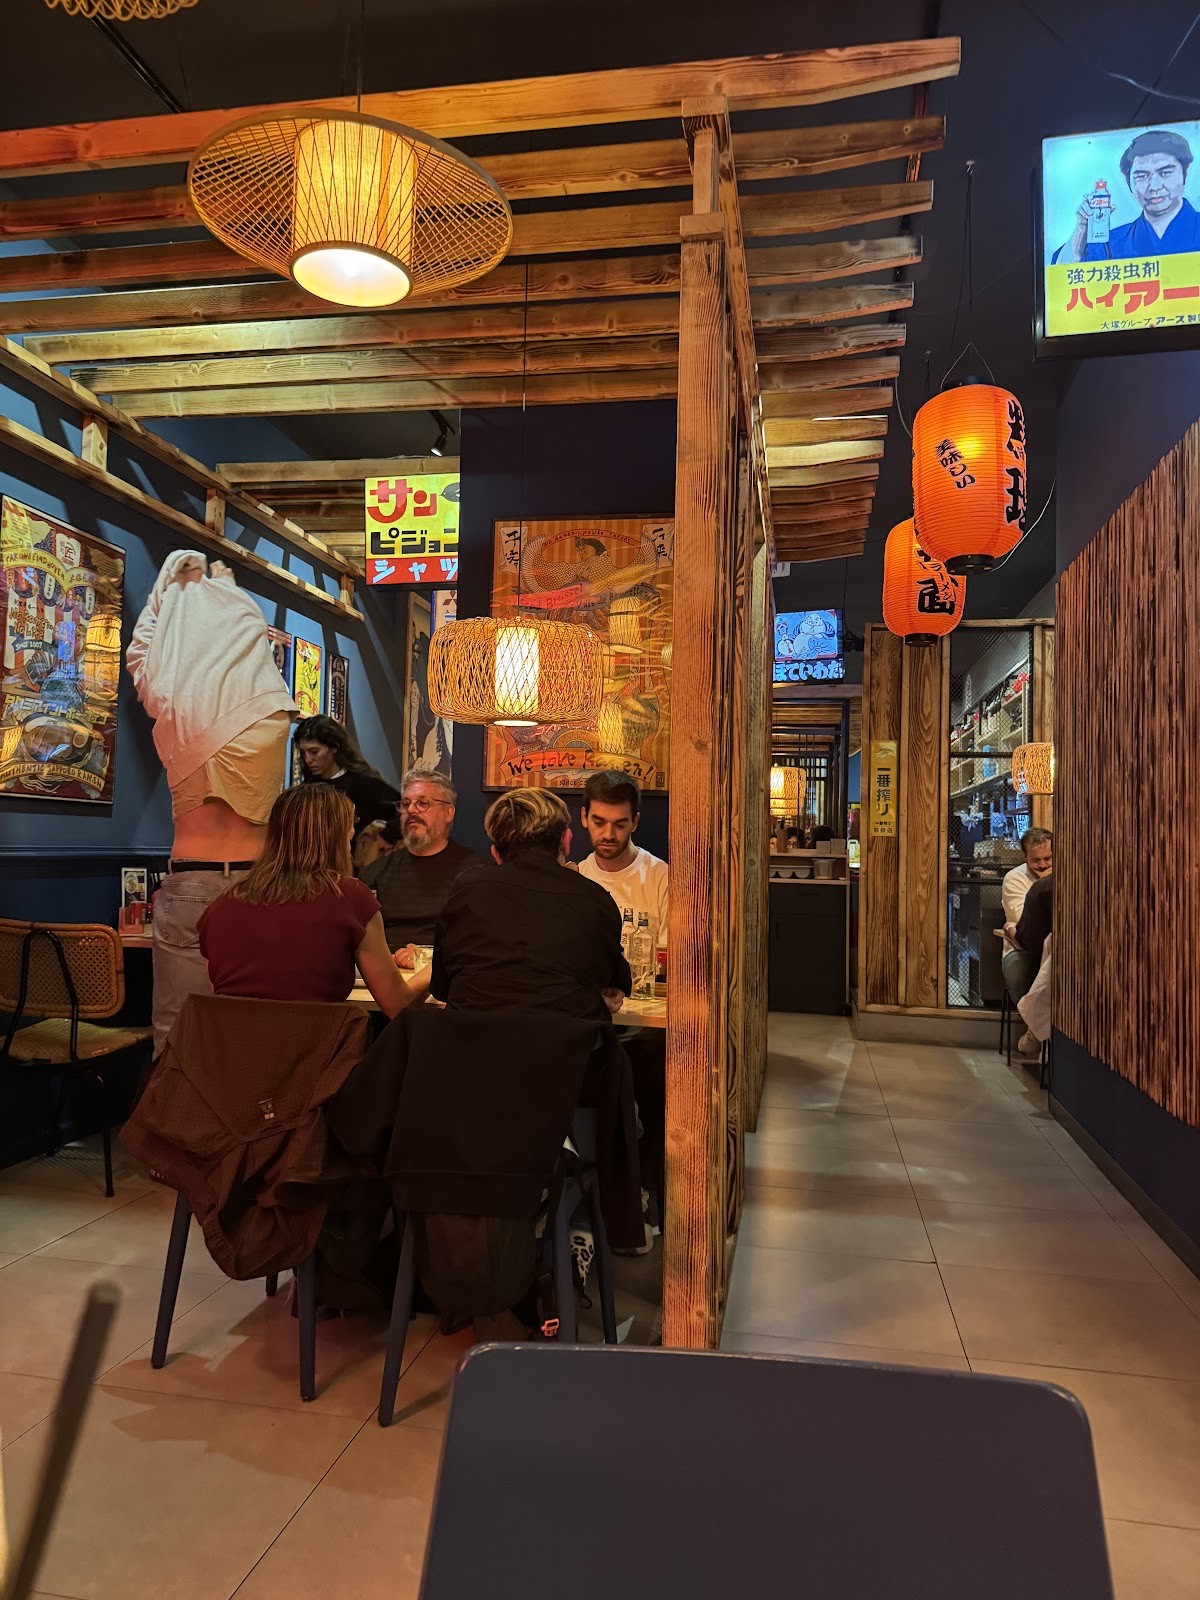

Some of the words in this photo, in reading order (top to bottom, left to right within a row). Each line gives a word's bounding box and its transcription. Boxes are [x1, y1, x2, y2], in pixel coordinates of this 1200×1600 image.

[1066, 260, 1160, 285] 強力殺虫剤
[1066, 280, 1200, 315] ハイアー
[935, 438, 976, 489] 美味しい
[366, 479, 438, 524] サン
[77, 767, 102, 788] RAMEN
[508, 753, 533, 776] We
[876, 767, 891, 817] 一番搾り
